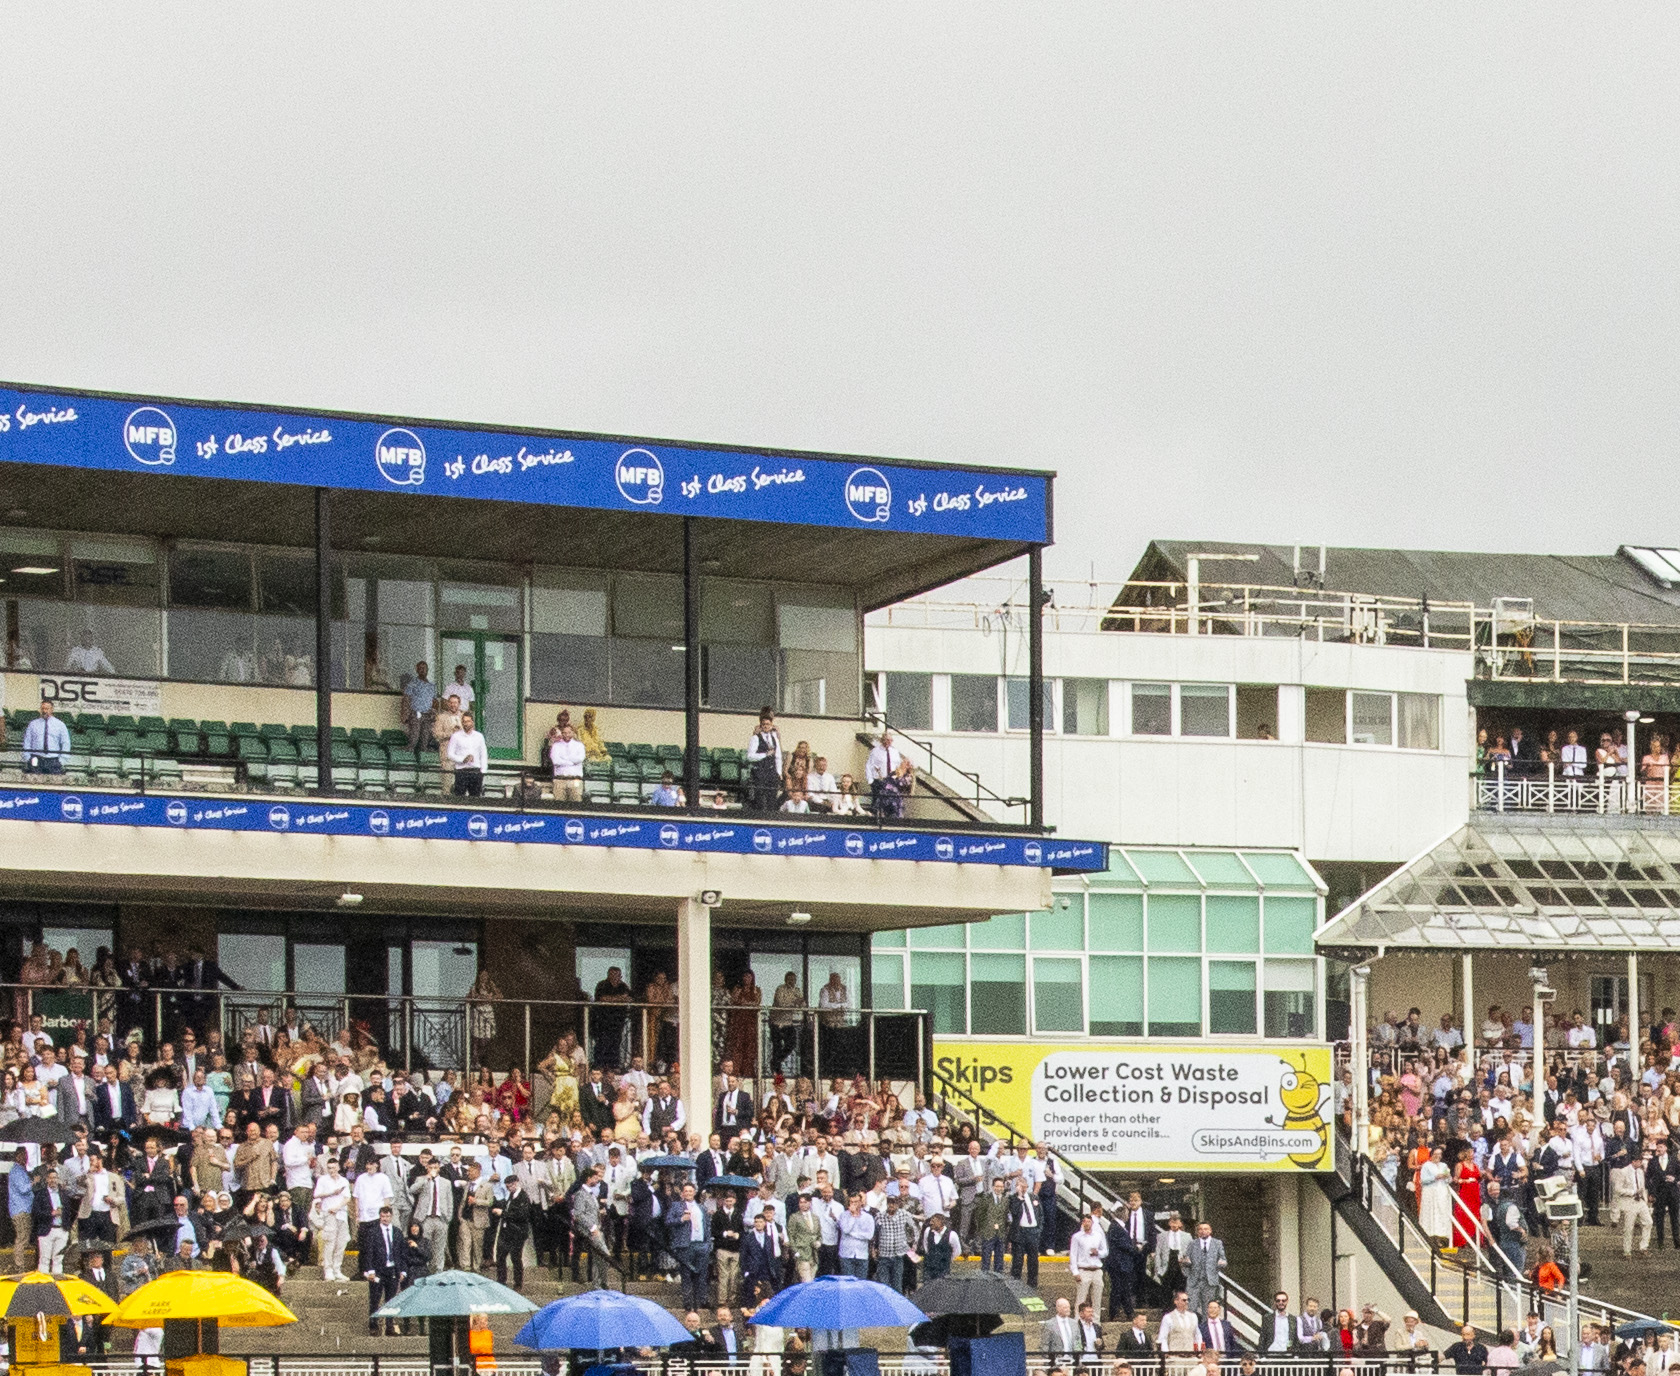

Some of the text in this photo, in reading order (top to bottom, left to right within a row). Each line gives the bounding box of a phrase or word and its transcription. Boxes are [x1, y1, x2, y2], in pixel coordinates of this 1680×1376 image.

[15, 404, 78, 430] Service
[128, 424, 332, 459] MFB 1st Class Service
[380, 445, 574, 480] MFB 1st Class Service
[620, 465, 806, 499] MFB 1st Class Service
[849, 484, 1028, 516] MFB 1st Class Service
[40, 678, 99, 702] DSE
[936, 1056, 1014, 1092] Skips
[1043, 1062, 1239, 1082] Lower Cost Waste
[1043, 1084, 1269, 1110] Collection & Disposal
[1043, 1112, 1162, 1128] Cheaper than other
[1043, 1126, 1171, 1141] providers & councils...
[1199, 1134, 1314, 1150] SkipsAndBins.com
